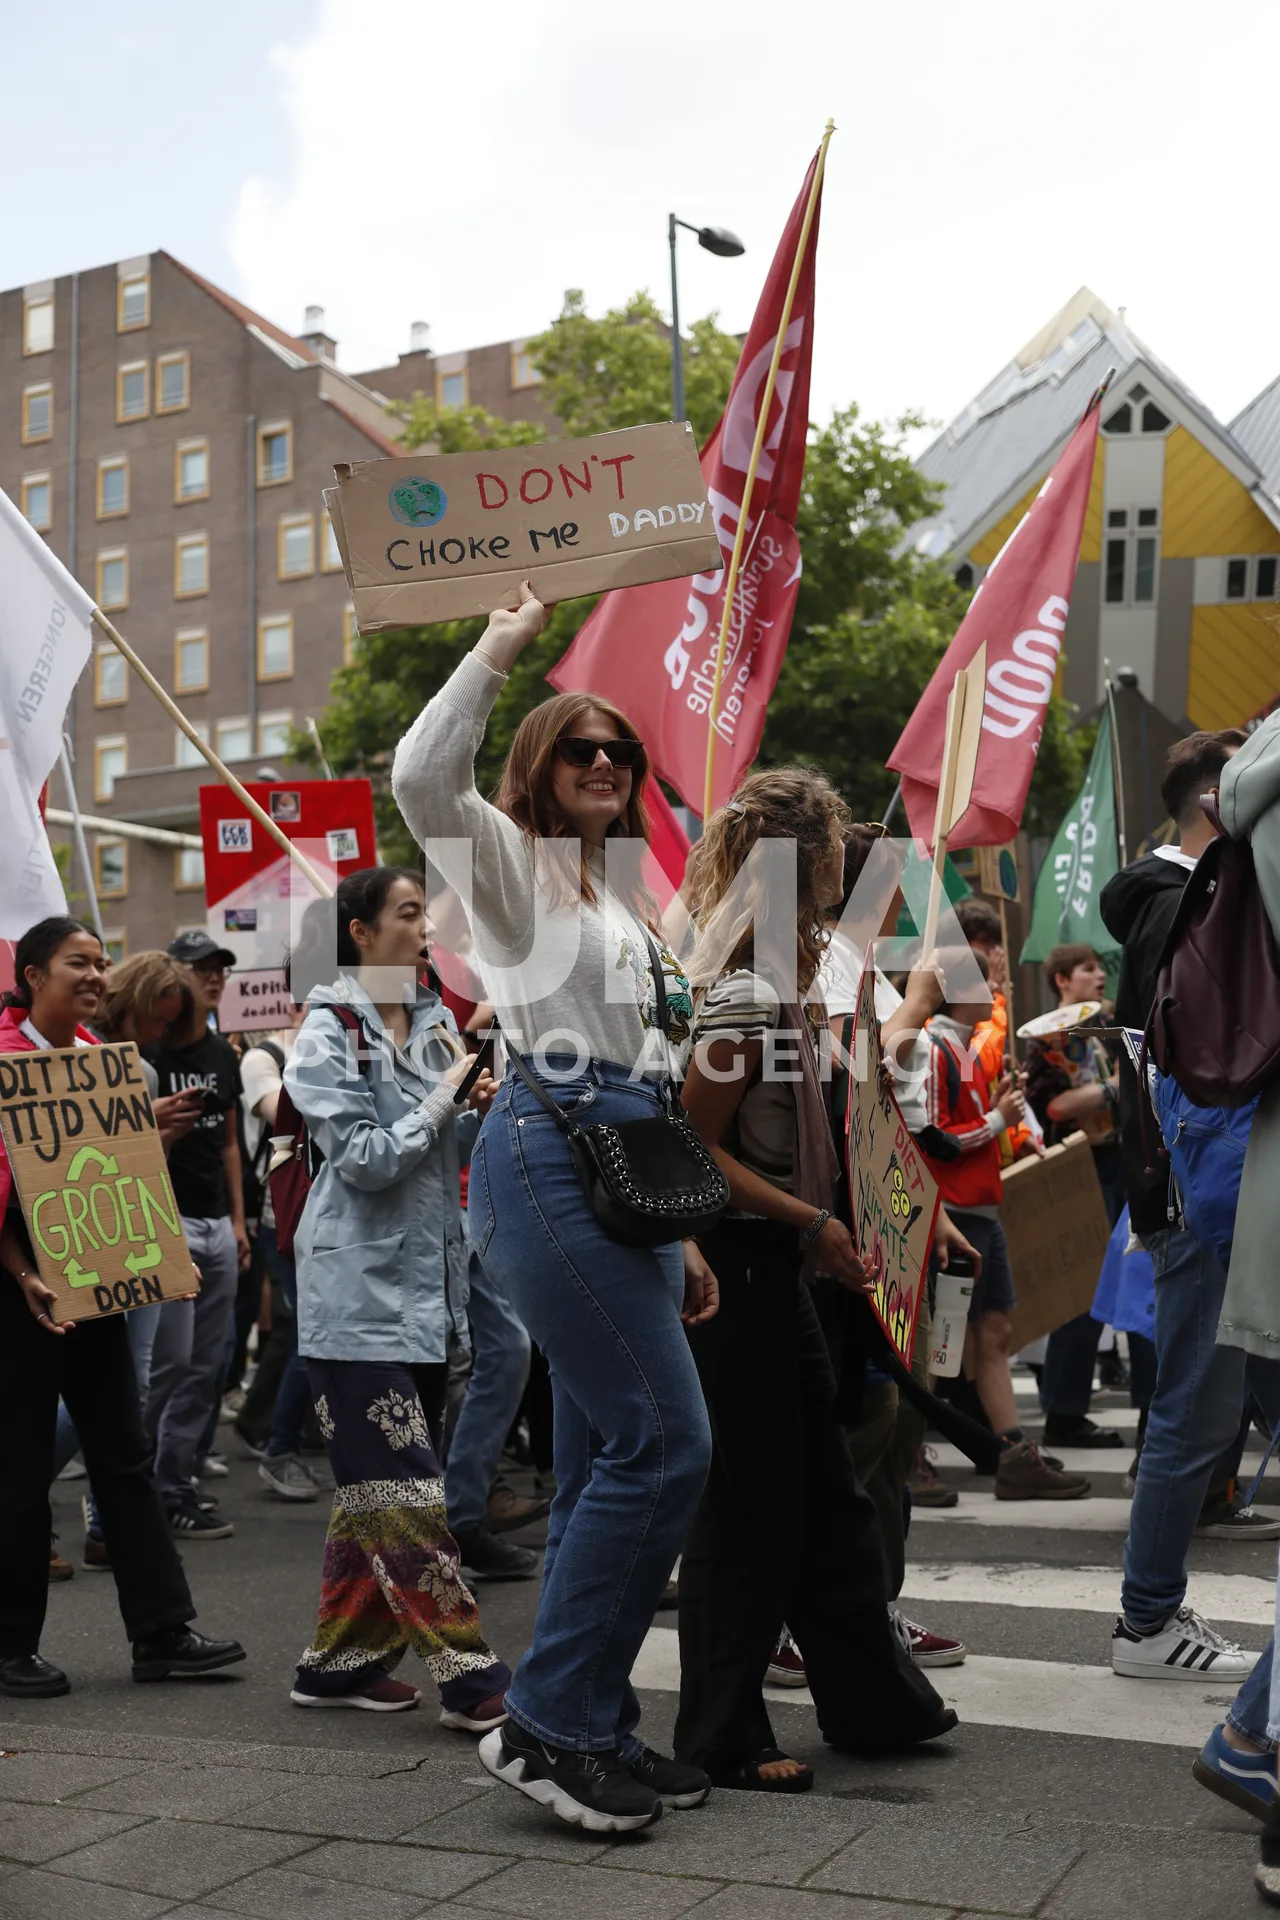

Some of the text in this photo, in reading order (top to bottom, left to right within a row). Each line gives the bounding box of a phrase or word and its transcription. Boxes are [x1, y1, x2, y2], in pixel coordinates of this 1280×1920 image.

[476, 454, 635, 510] DON'T
[609, 501, 707, 538] DADDY
[0, 1046, 143, 1100] DIT IS DE
[180, 1072, 218, 1093] LOVE
[1, 1091, 156, 1163] TIJD VAN
[32, 1171, 182, 1262] GROEN
[93, 1274, 165, 1313] DOEN
